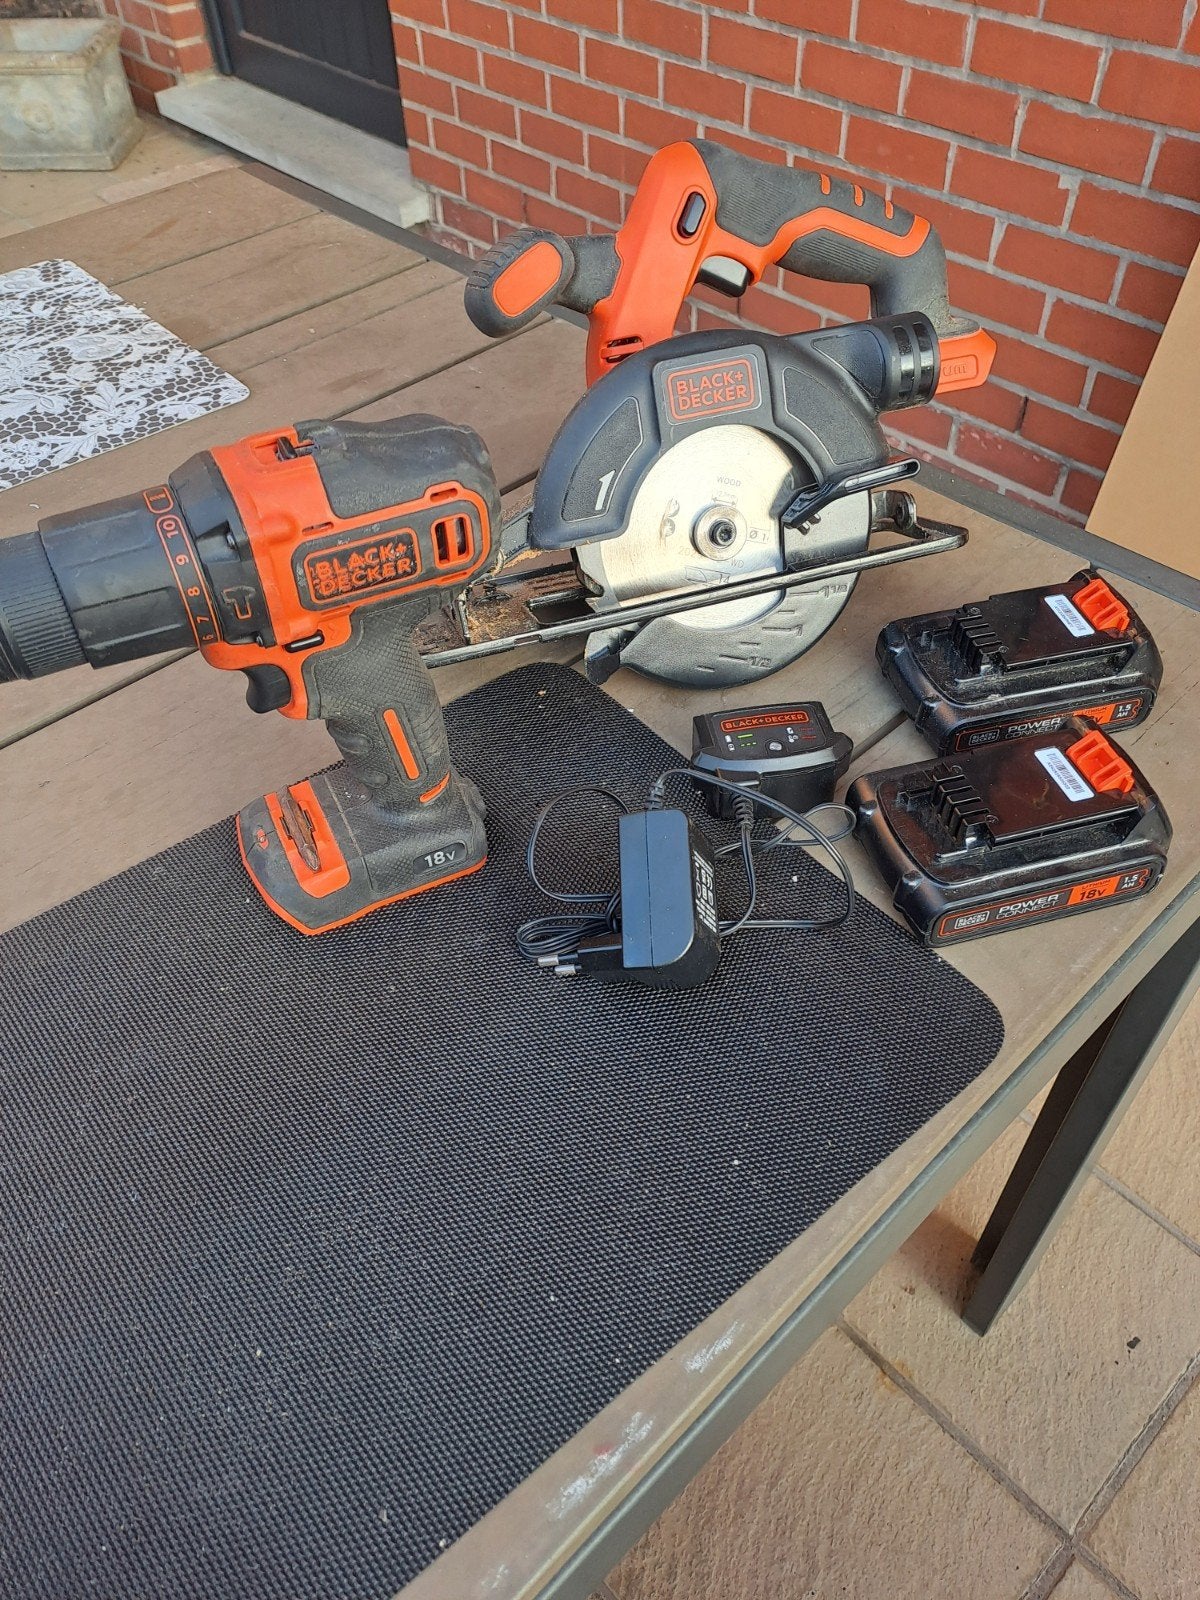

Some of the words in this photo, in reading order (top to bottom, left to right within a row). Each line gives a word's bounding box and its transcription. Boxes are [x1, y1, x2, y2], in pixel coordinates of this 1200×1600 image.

[676, 370, 744, 395] BLACK+
[679, 384, 748, 411] DECKER
[594, 468, 616, 511] 1
[162, 520, 179, 539] 10
[315, 541, 407, 580] BLACK+
[319, 557, 412, 596] DECKER
[187, 586, 201, 597] 8
[196, 616, 209, 624] 7
[1119, 703, 1132, 712] 1.5
[1005, 723, 1060, 739] CONNECT
[1008, 717, 1062, 733] POWER
[1124, 874, 1139, 883] 1.5
[996, 900, 1060, 920] CONNECT
[999, 894, 1060, 914] POWER
